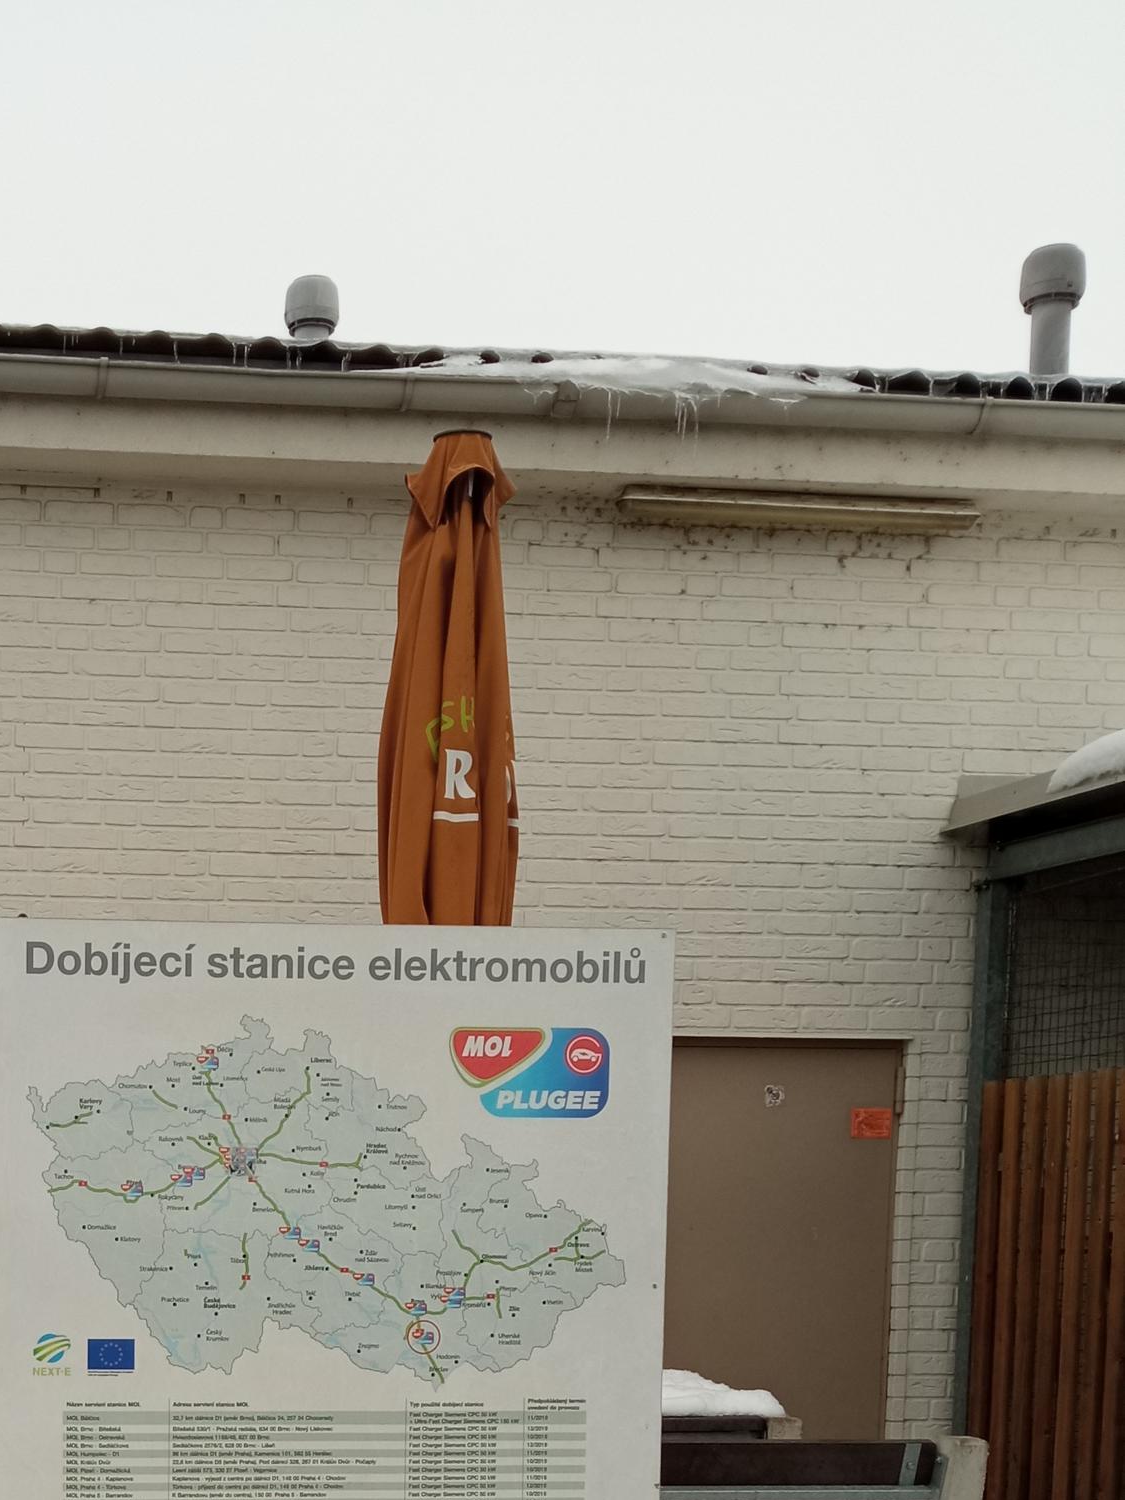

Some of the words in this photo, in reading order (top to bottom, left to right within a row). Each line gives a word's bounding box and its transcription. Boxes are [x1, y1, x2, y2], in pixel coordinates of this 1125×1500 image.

[26, 940, 196, 984] Dobíjecí
[207, 944, 355, 981] stanice
[369, 947, 646, 984] elektromobilů
[462, 1036, 513, 1057] MOL
[496, 1090, 601, 1110] PLUGEE
